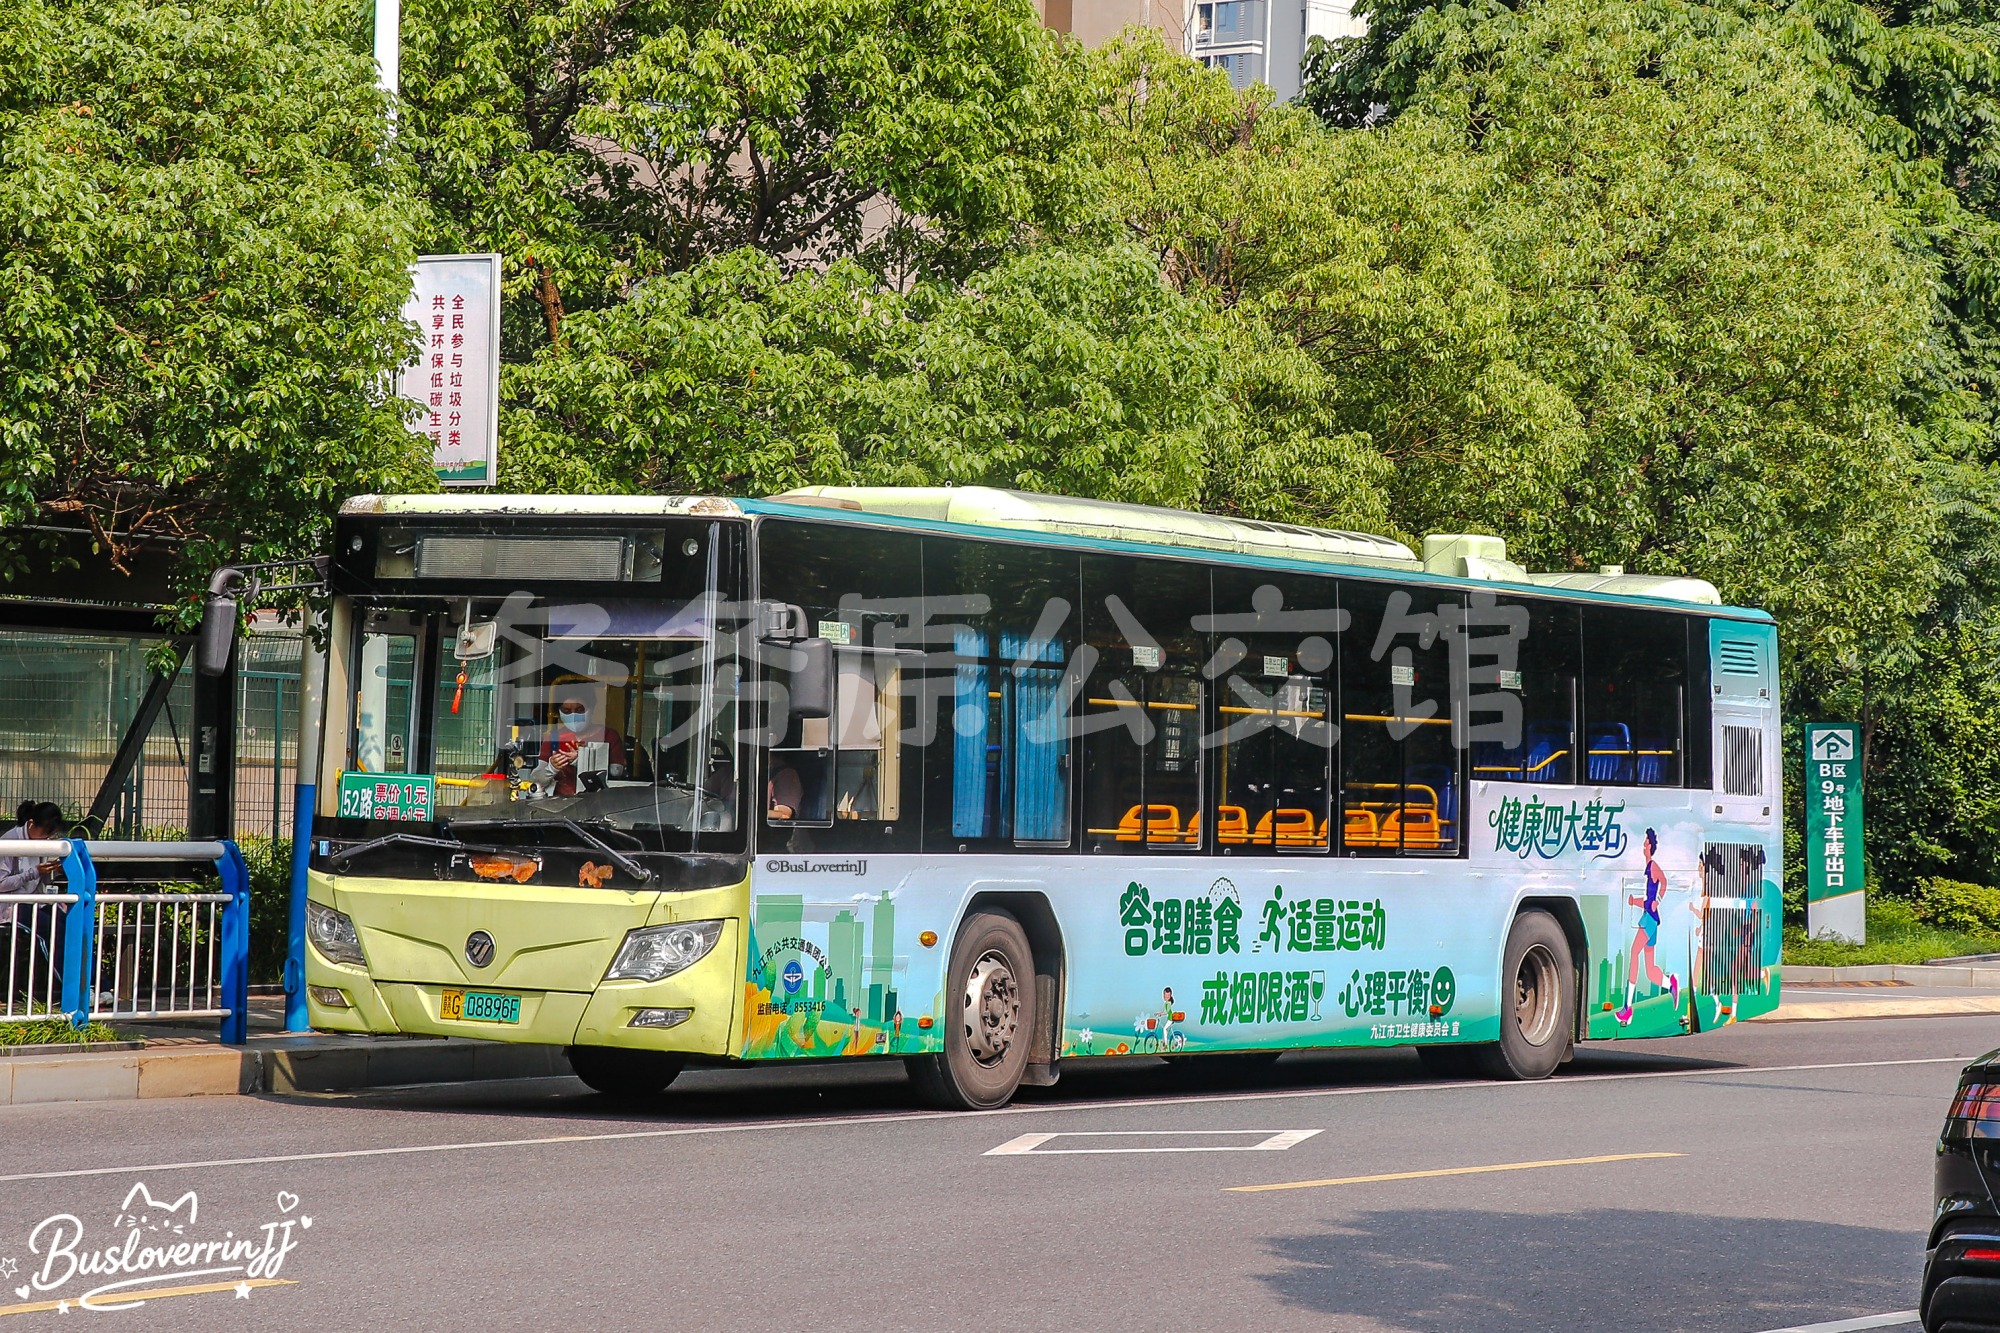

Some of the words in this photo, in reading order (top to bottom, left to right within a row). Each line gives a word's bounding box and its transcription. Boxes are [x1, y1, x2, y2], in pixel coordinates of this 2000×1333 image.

[448, 294, 465, 446] 全民参与垃圾分类
[1489, 795, 1627, 861] 健康四大基石
[1119, 889, 1243, 956] 合理膳食
[1287, 898, 1386, 952] 适量运动
[752, 937, 833, 980] 九江市公共交通集团公司
[1200, 970, 1311, 1026] 戒烟限酒
[1338, 968, 1431, 1018] 心理平衡
[1370, 1021, 1450, 1039] 九江市卫生健康委员会
